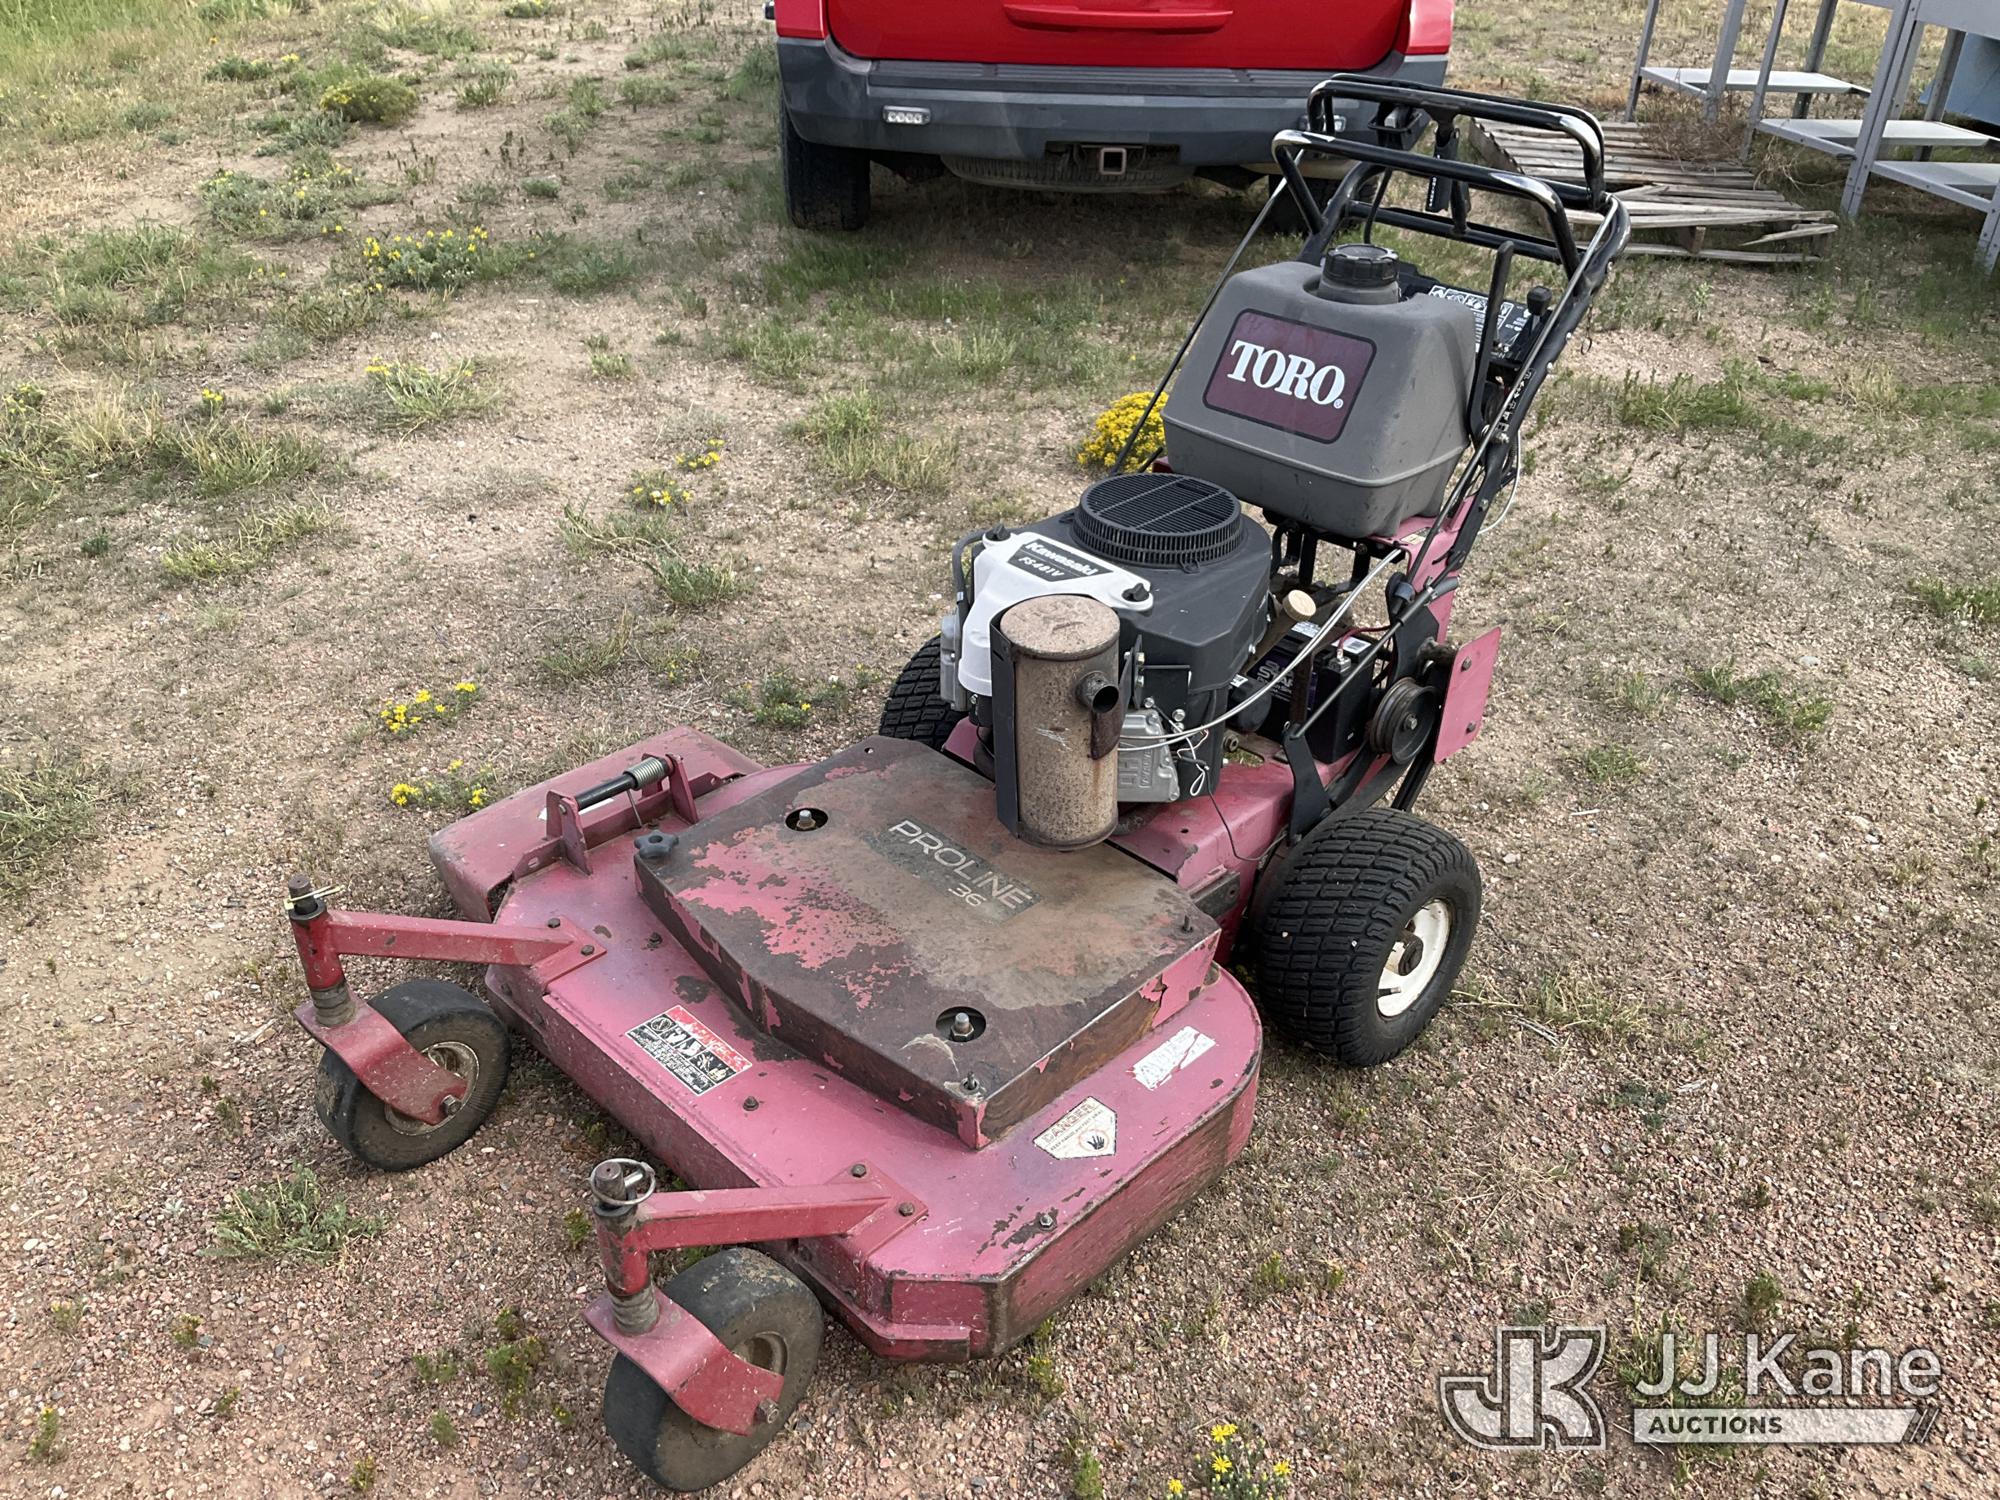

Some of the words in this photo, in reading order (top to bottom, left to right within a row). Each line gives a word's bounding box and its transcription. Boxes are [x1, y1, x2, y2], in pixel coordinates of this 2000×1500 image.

[1025, 542, 1099, 576] Kawasaki
[888, 819, 1033, 909] PROLINE
[948, 882, 987, 907] 36
